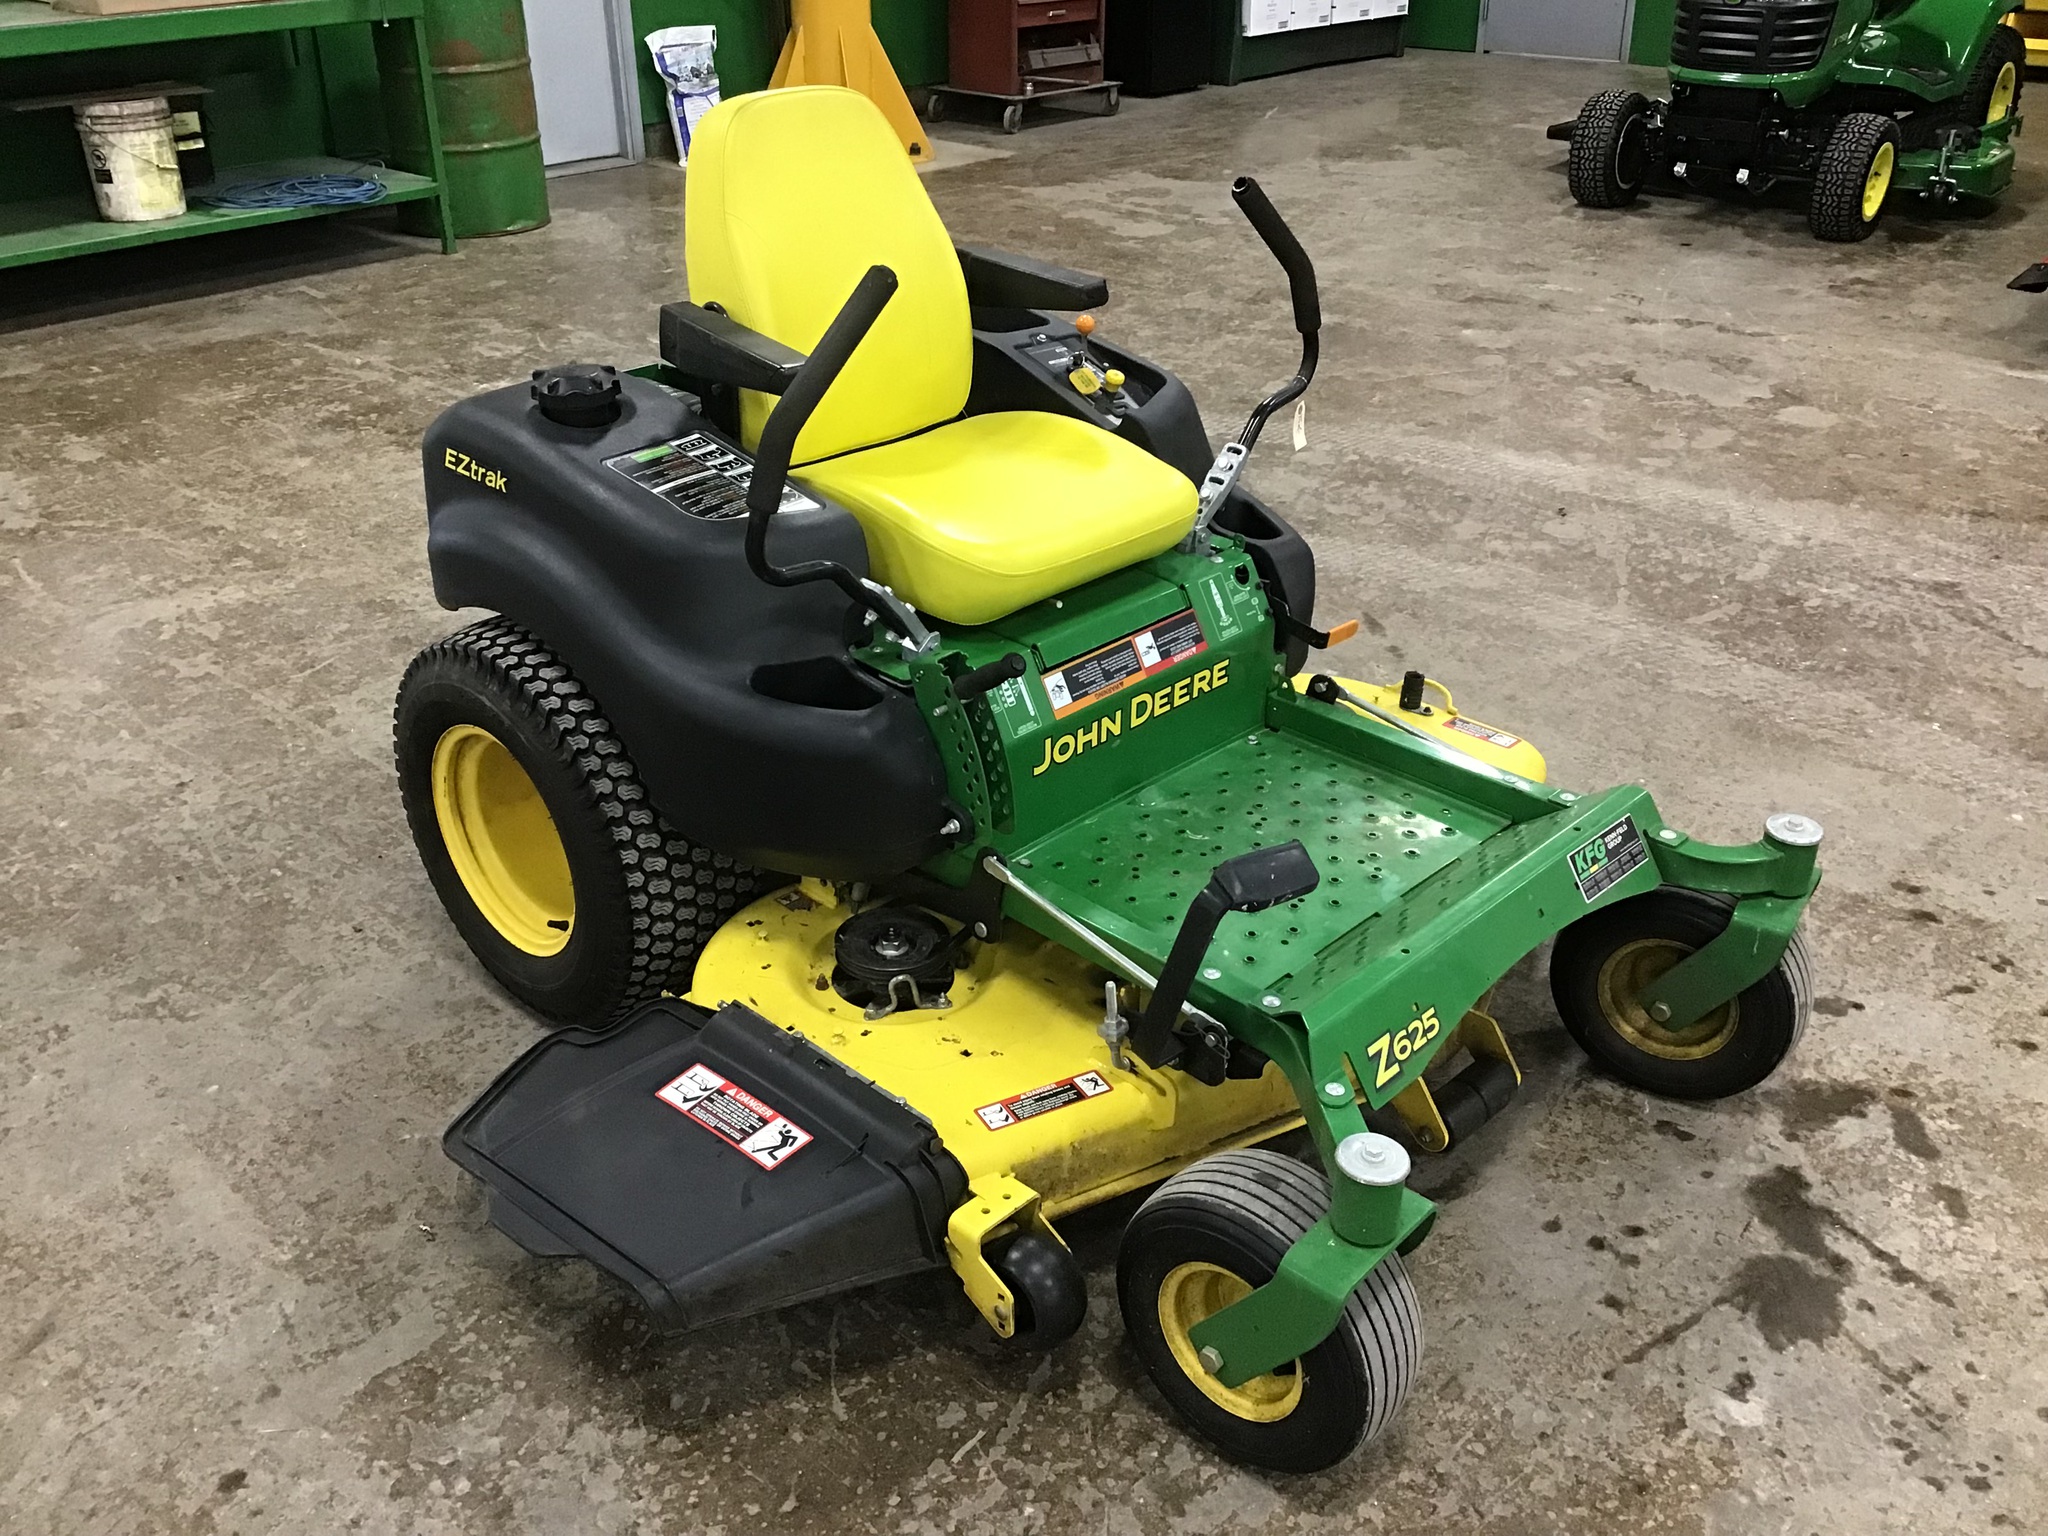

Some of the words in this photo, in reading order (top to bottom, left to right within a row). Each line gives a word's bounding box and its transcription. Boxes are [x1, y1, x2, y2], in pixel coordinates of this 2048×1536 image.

[445, 447, 508, 493] EZtrak
[1033, 709, 1122, 776] JOHN
[1130, 658, 1230, 729] DEERE
[1575, 838, 1606, 874] KFG
[1607, 835, 1622, 850] GROUP
[1367, 1006, 1440, 1089] Z625
[736, 1092, 774, 1118] DANGER
[1026, 1083, 1058, 1096] DANGER
